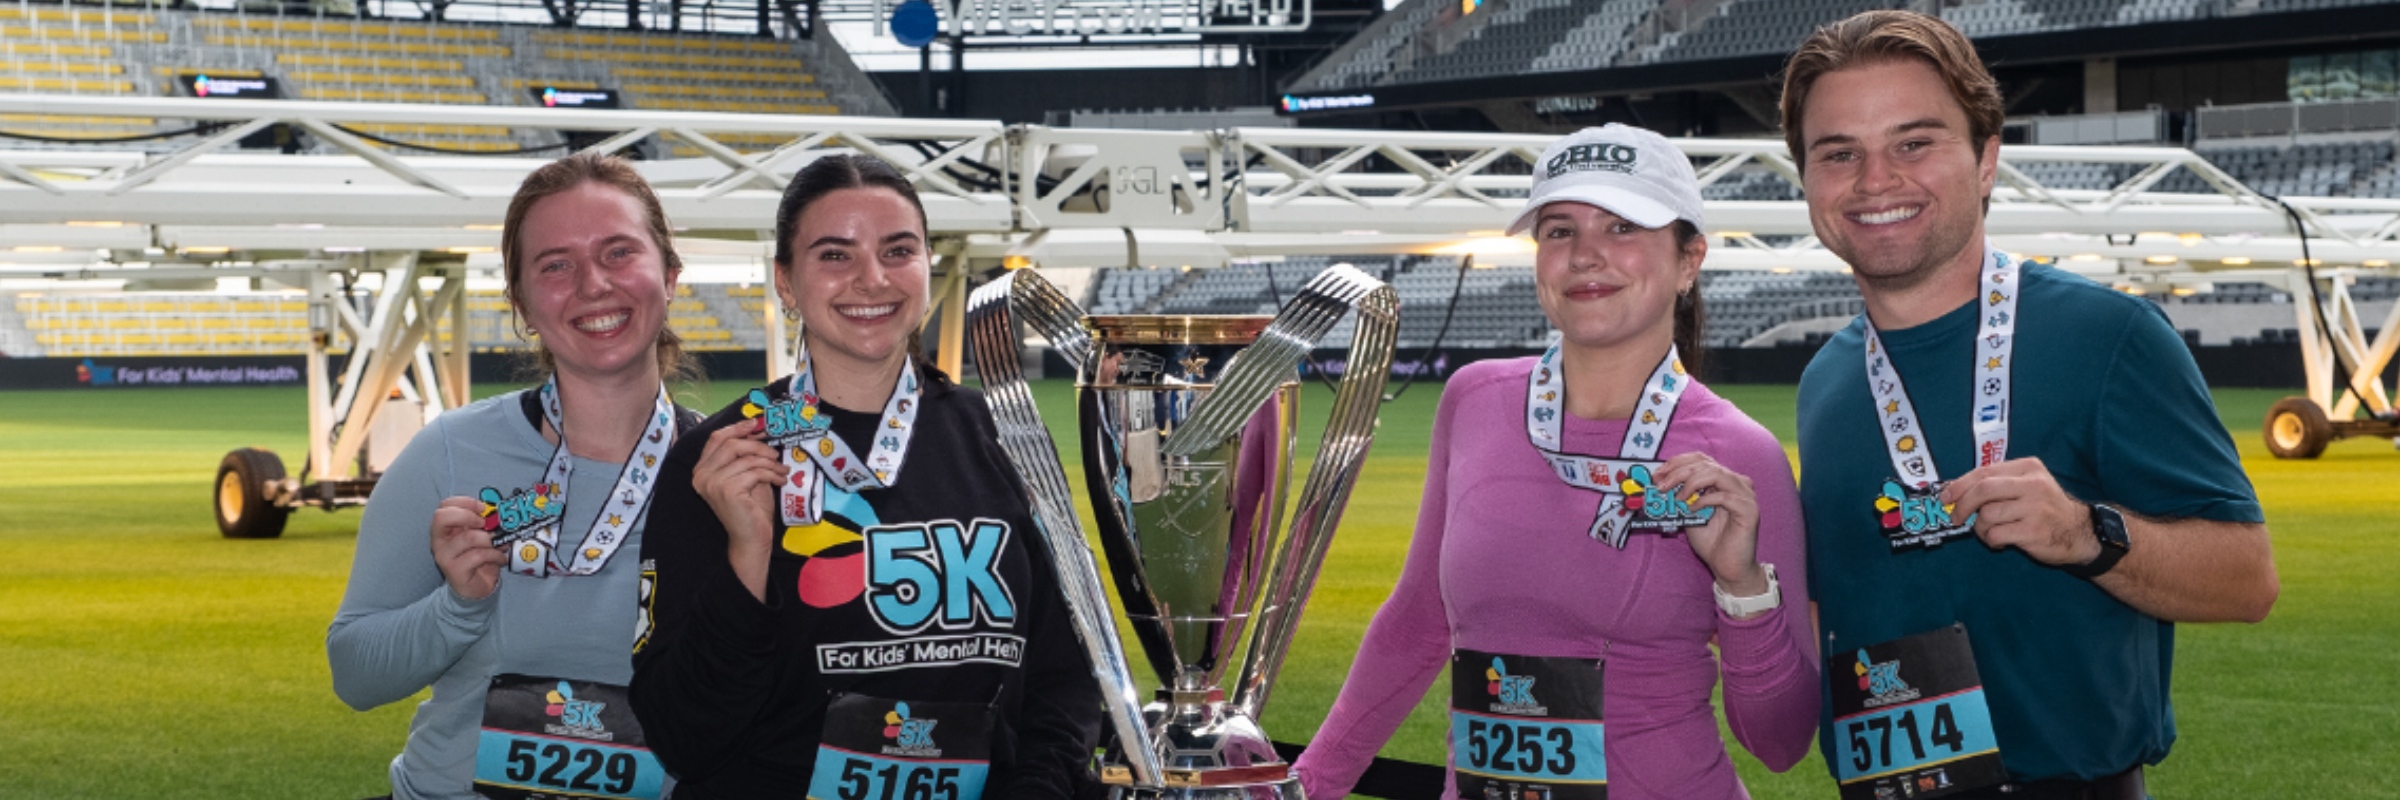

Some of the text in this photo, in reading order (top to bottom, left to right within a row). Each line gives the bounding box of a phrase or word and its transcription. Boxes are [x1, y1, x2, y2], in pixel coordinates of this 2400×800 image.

[1547, 143, 1638, 176] OHIO
[118, 367, 144, 383] For
[187, 366, 242, 382] Mental
[246, 365, 298, 382] Health
[767, 400, 812, 437] 5K
[1167, 472, 1201, 486] MLS
[499, 492, 545, 532] 5K
[1901, 497, 1952, 534] 5K
[865, 520, 1015, 633] 5K
[825, 649, 858, 668] For
[863, 643, 910, 667] Kids'
[1499, 676, 1538, 706] 5K
[1869, 660, 1908, 697] 5K
[562, 700, 605, 731] 5K
[898, 718, 938, 748] 5K
[1469, 720, 1576, 775] 5253
[1849, 703, 1964, 772] 5714
[506, 739, 637, 794] 5229
[838, 758, 960, 800] 5165
